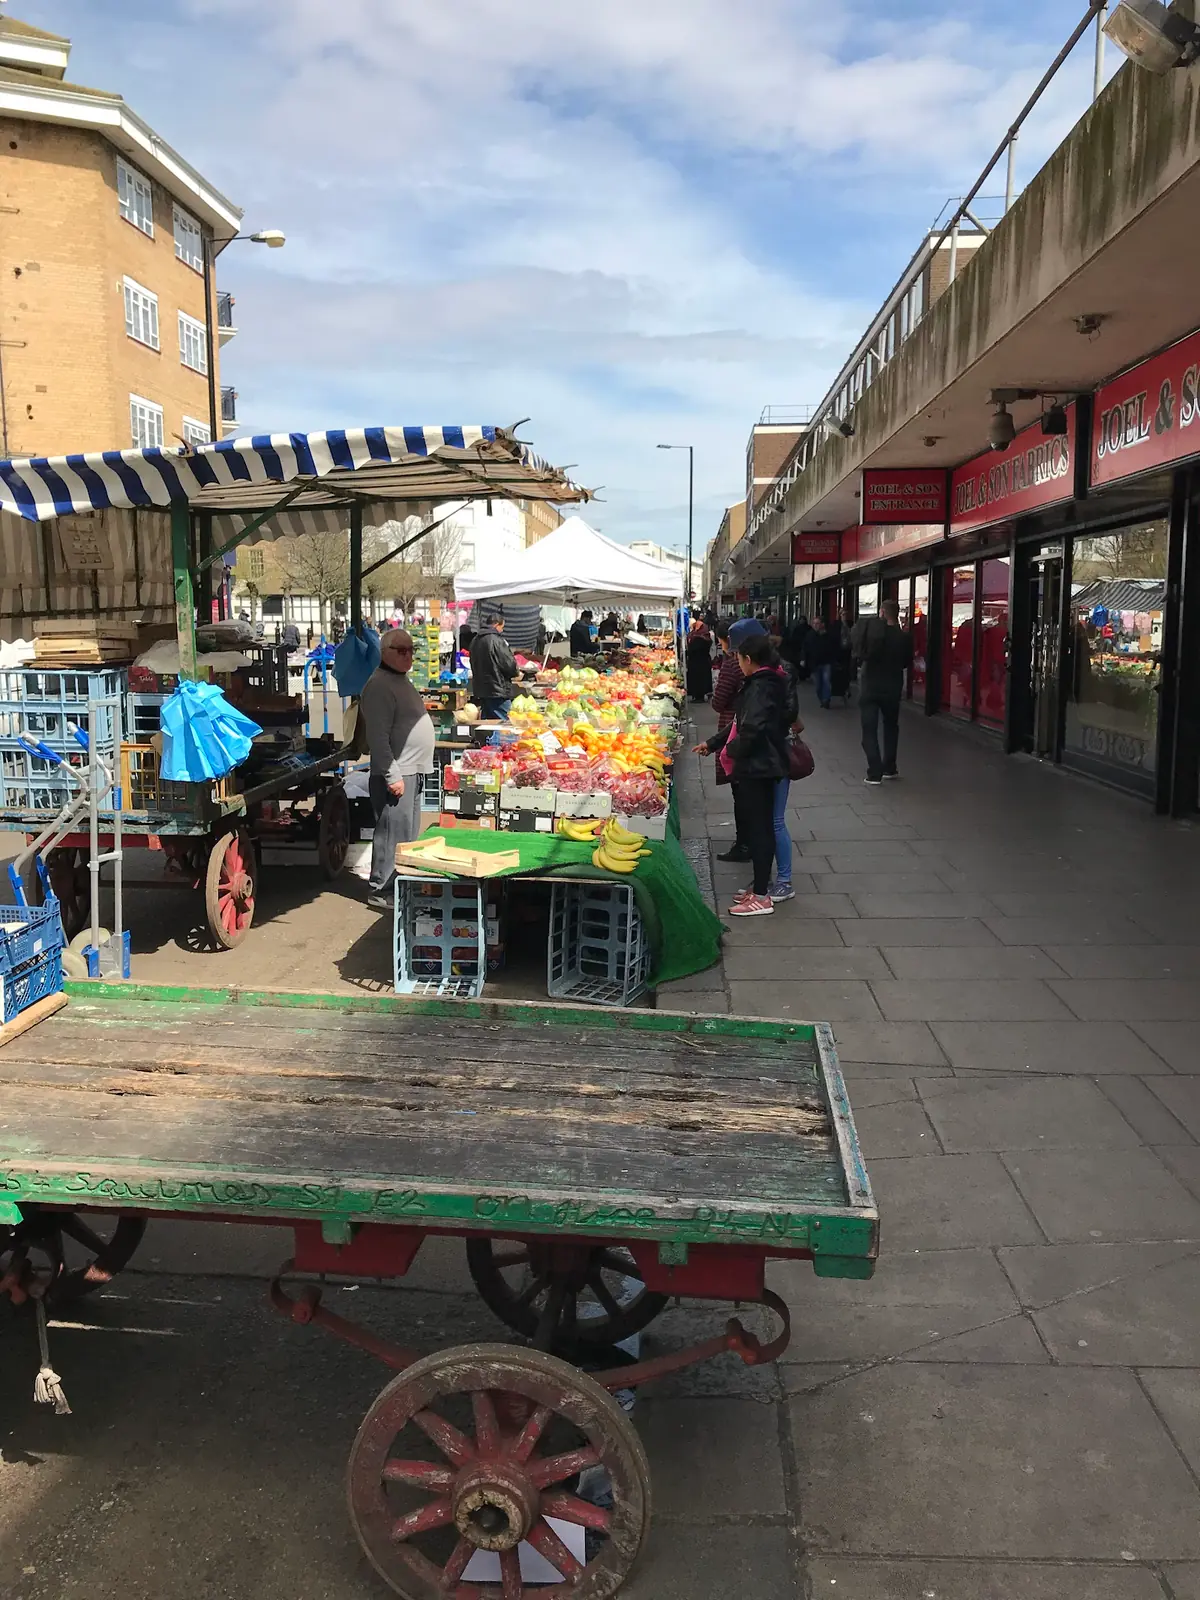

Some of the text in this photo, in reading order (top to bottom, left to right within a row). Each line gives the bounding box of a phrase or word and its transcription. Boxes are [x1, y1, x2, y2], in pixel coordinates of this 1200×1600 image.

[1097, 390, 1151, 459] JOEL
[1154, 378, 1176, 435] &
[868, 483, 941, 495] JOEL & SON
[954, 477, 977, 516] JOEL
[977, 472, 989, 508] &
[988, 460, 1010, 504] SON
[1011, 434, 1070, 495] FABRICS
[870, 499, 938, 511] ENTRANCE
